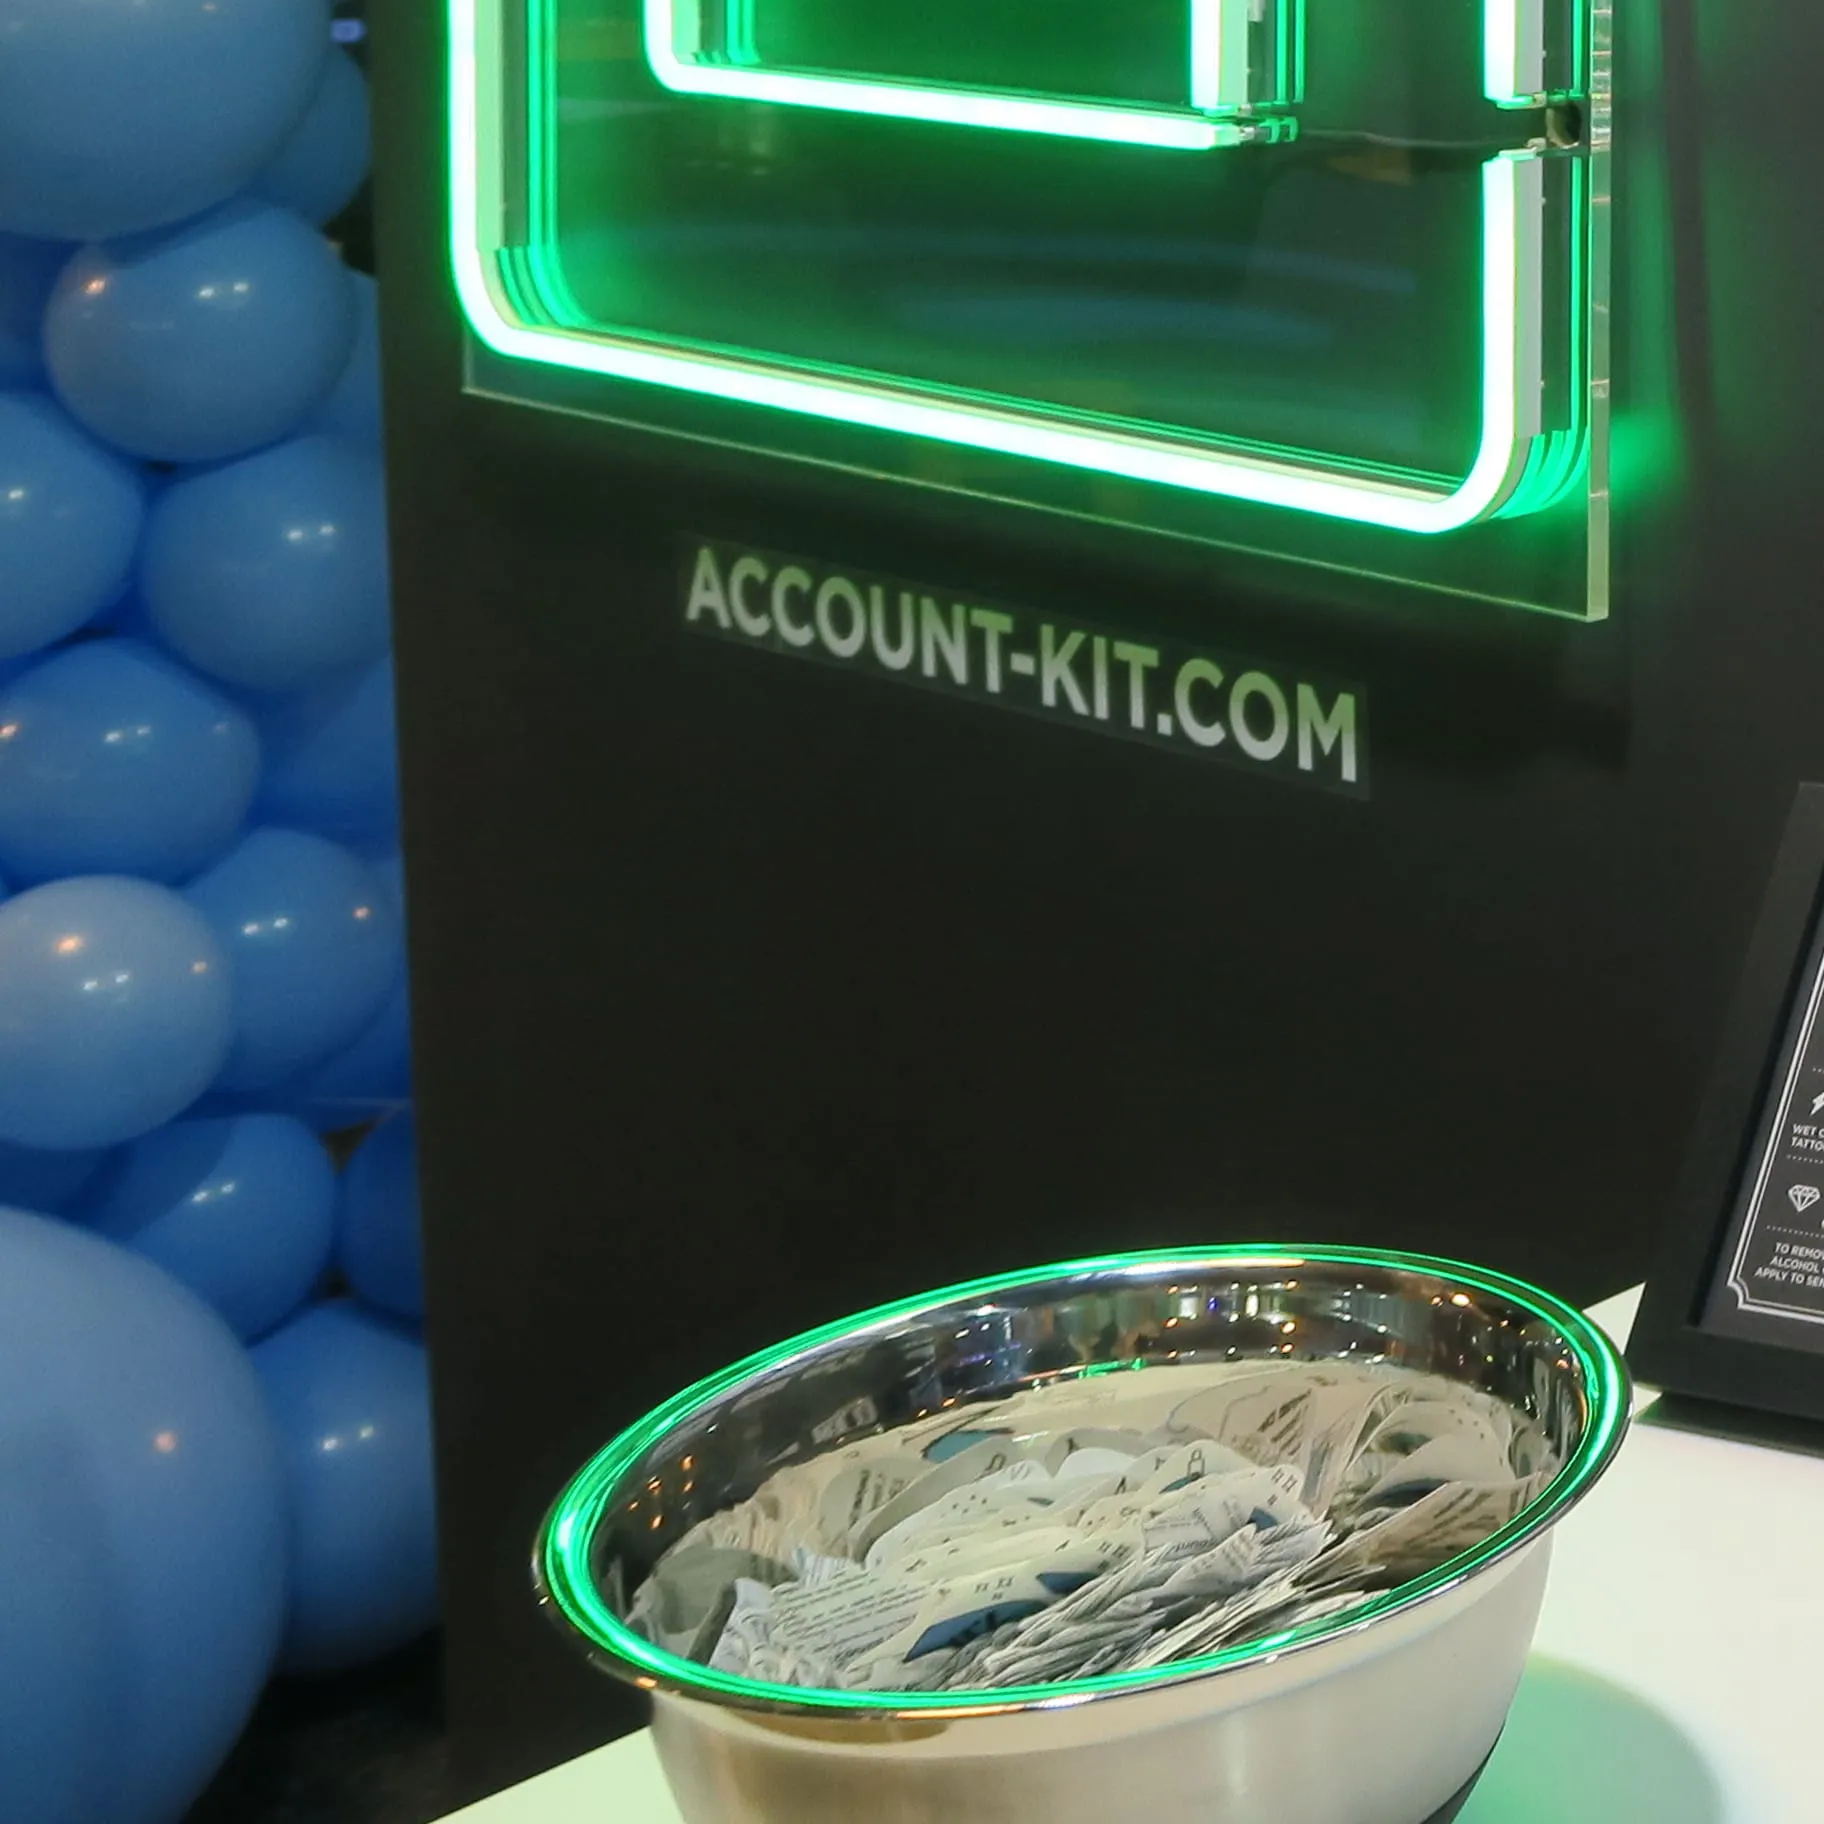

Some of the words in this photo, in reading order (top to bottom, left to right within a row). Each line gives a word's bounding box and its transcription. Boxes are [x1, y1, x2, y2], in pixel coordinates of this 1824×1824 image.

[686, 546, 1357, 784] ACCOUNT-KIT.COM
[1792, 1124, 1816, 1136] WET
[1775, 1242, 1790, 1254] TO
[1770, 1256, 1820, 1274] ALCOHOL
[1754, 1267, 1787, 1282] APPLY
[1790, 1272, 1804, 1284] TO
